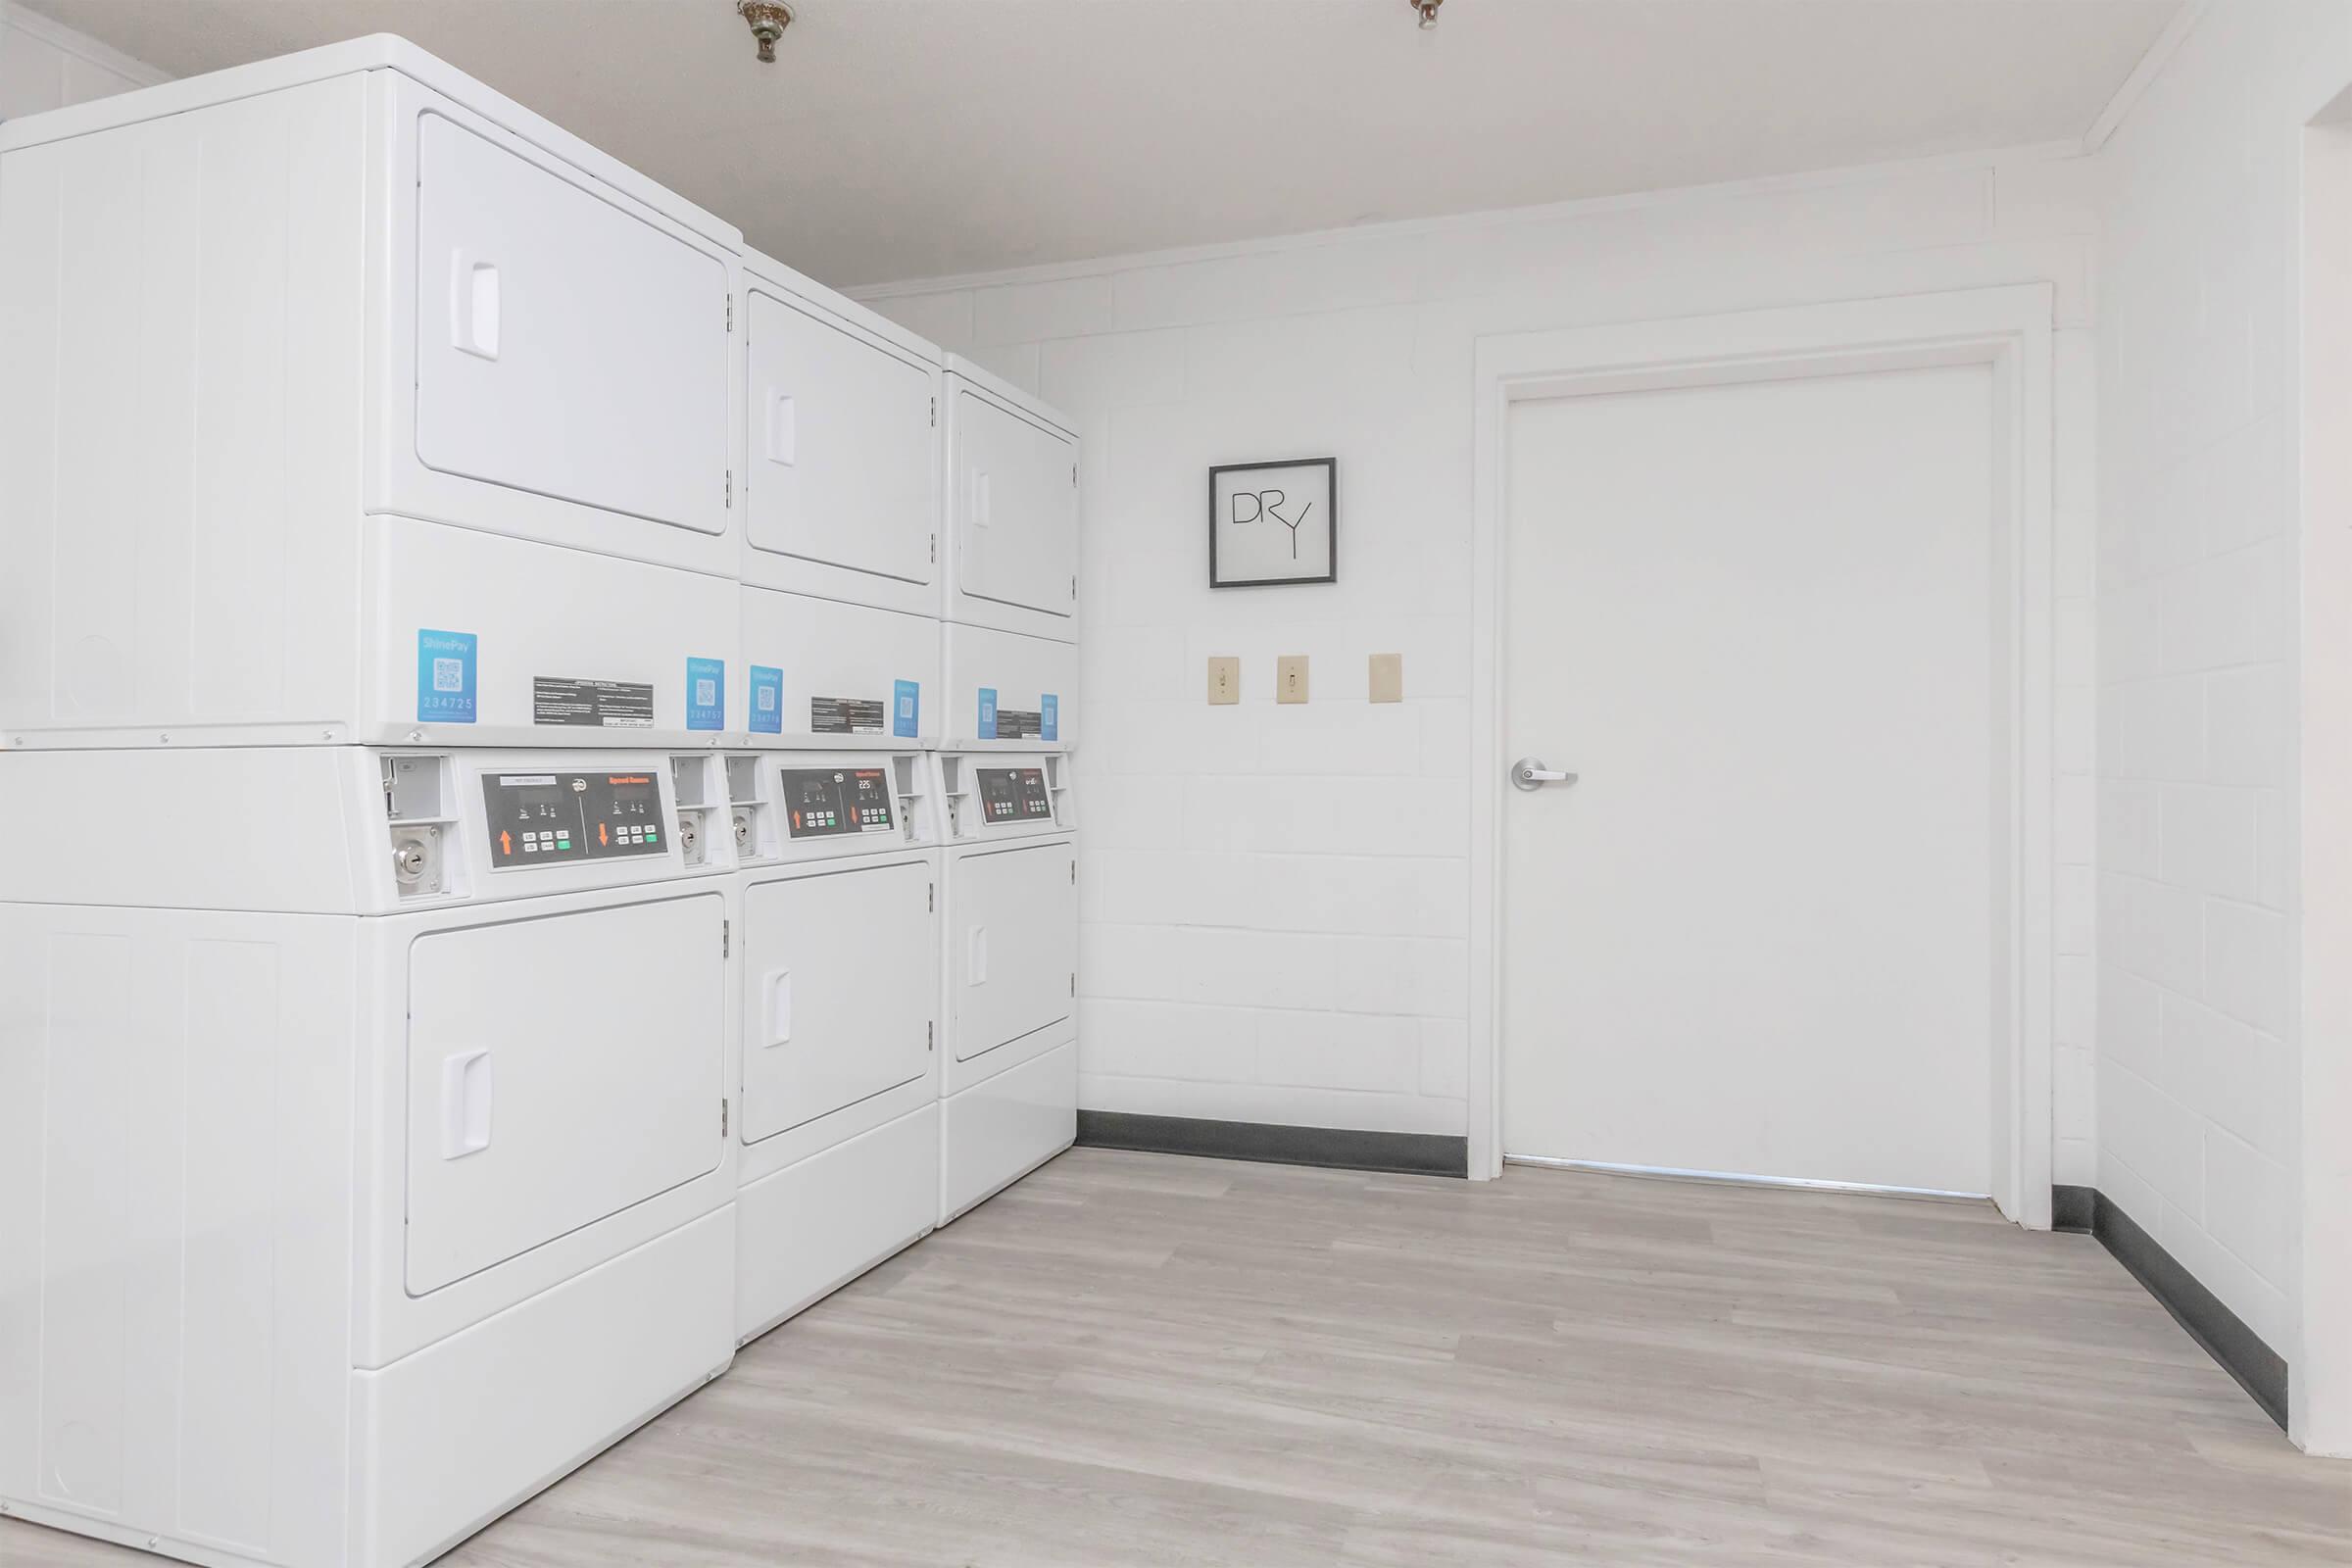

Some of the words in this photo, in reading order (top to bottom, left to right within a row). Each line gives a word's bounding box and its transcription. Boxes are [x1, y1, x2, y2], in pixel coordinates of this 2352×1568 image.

[1232, 489, 1312, 560] DRY
[422, 636, 468, 653] ShinePay
[423, 697, 473, 709] 234725
